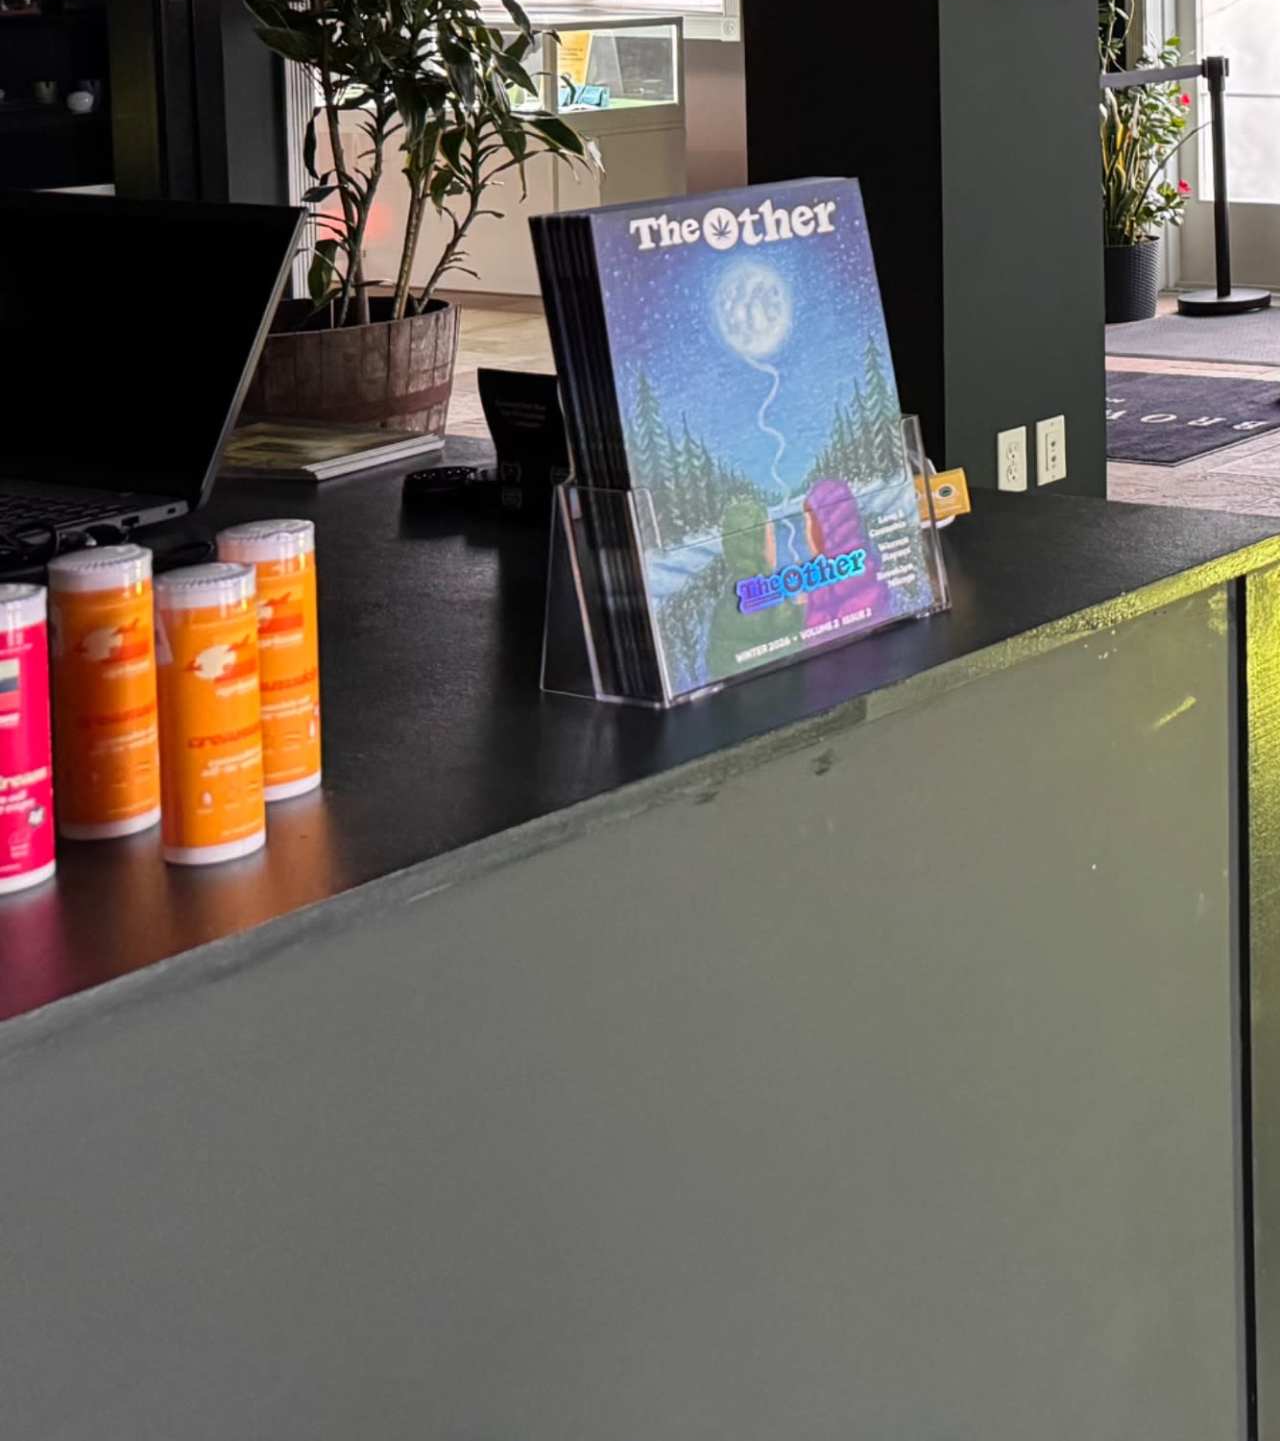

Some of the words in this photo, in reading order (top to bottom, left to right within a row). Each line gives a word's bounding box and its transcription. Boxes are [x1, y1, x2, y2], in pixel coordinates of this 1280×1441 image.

[630, 213, 700, 250] The
[703, 199, 836, 250] Other
[741, 576, 782, 599] The
[782, 550, 866, 593] Other
